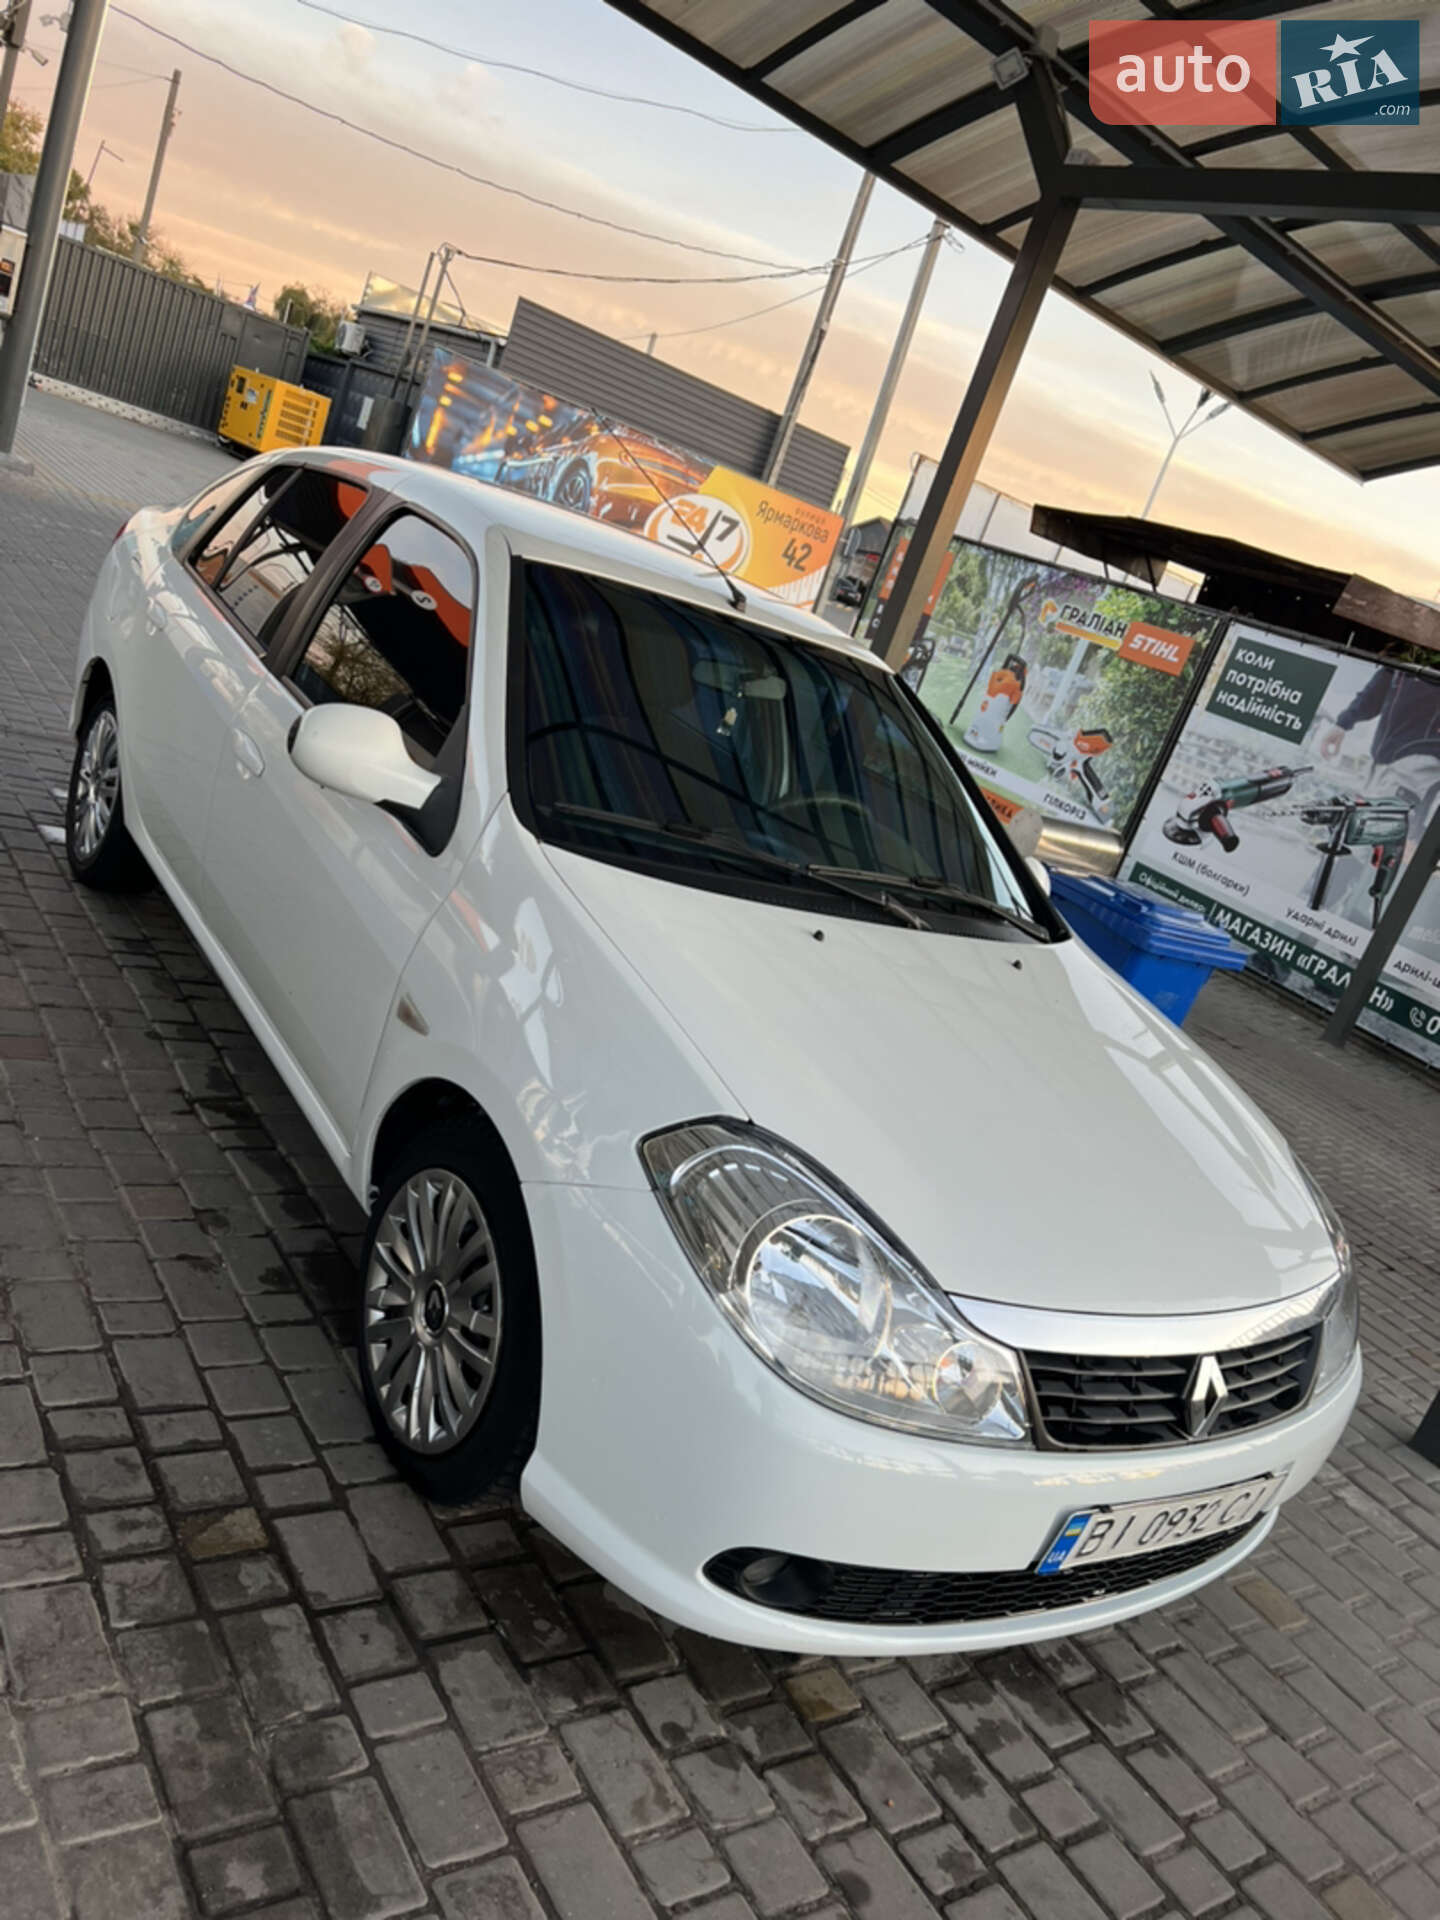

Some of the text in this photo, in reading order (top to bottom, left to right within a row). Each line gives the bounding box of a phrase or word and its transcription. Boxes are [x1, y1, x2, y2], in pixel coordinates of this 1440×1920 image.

[756, 500, 829, 543] Ярмаркова
[781, 538, 812, 572] 42
[1060, 604, 1128, 639] ГРАЛІАН
[1128, 633, 1180, 663] STIHL
[1235, 648, 1276, 671] коли
[1225, 669, 1303, 704] потрібна
[1215, 690, 1303, 730] надійність
[1214, 908, 1297, 962] МАГАЗИН
